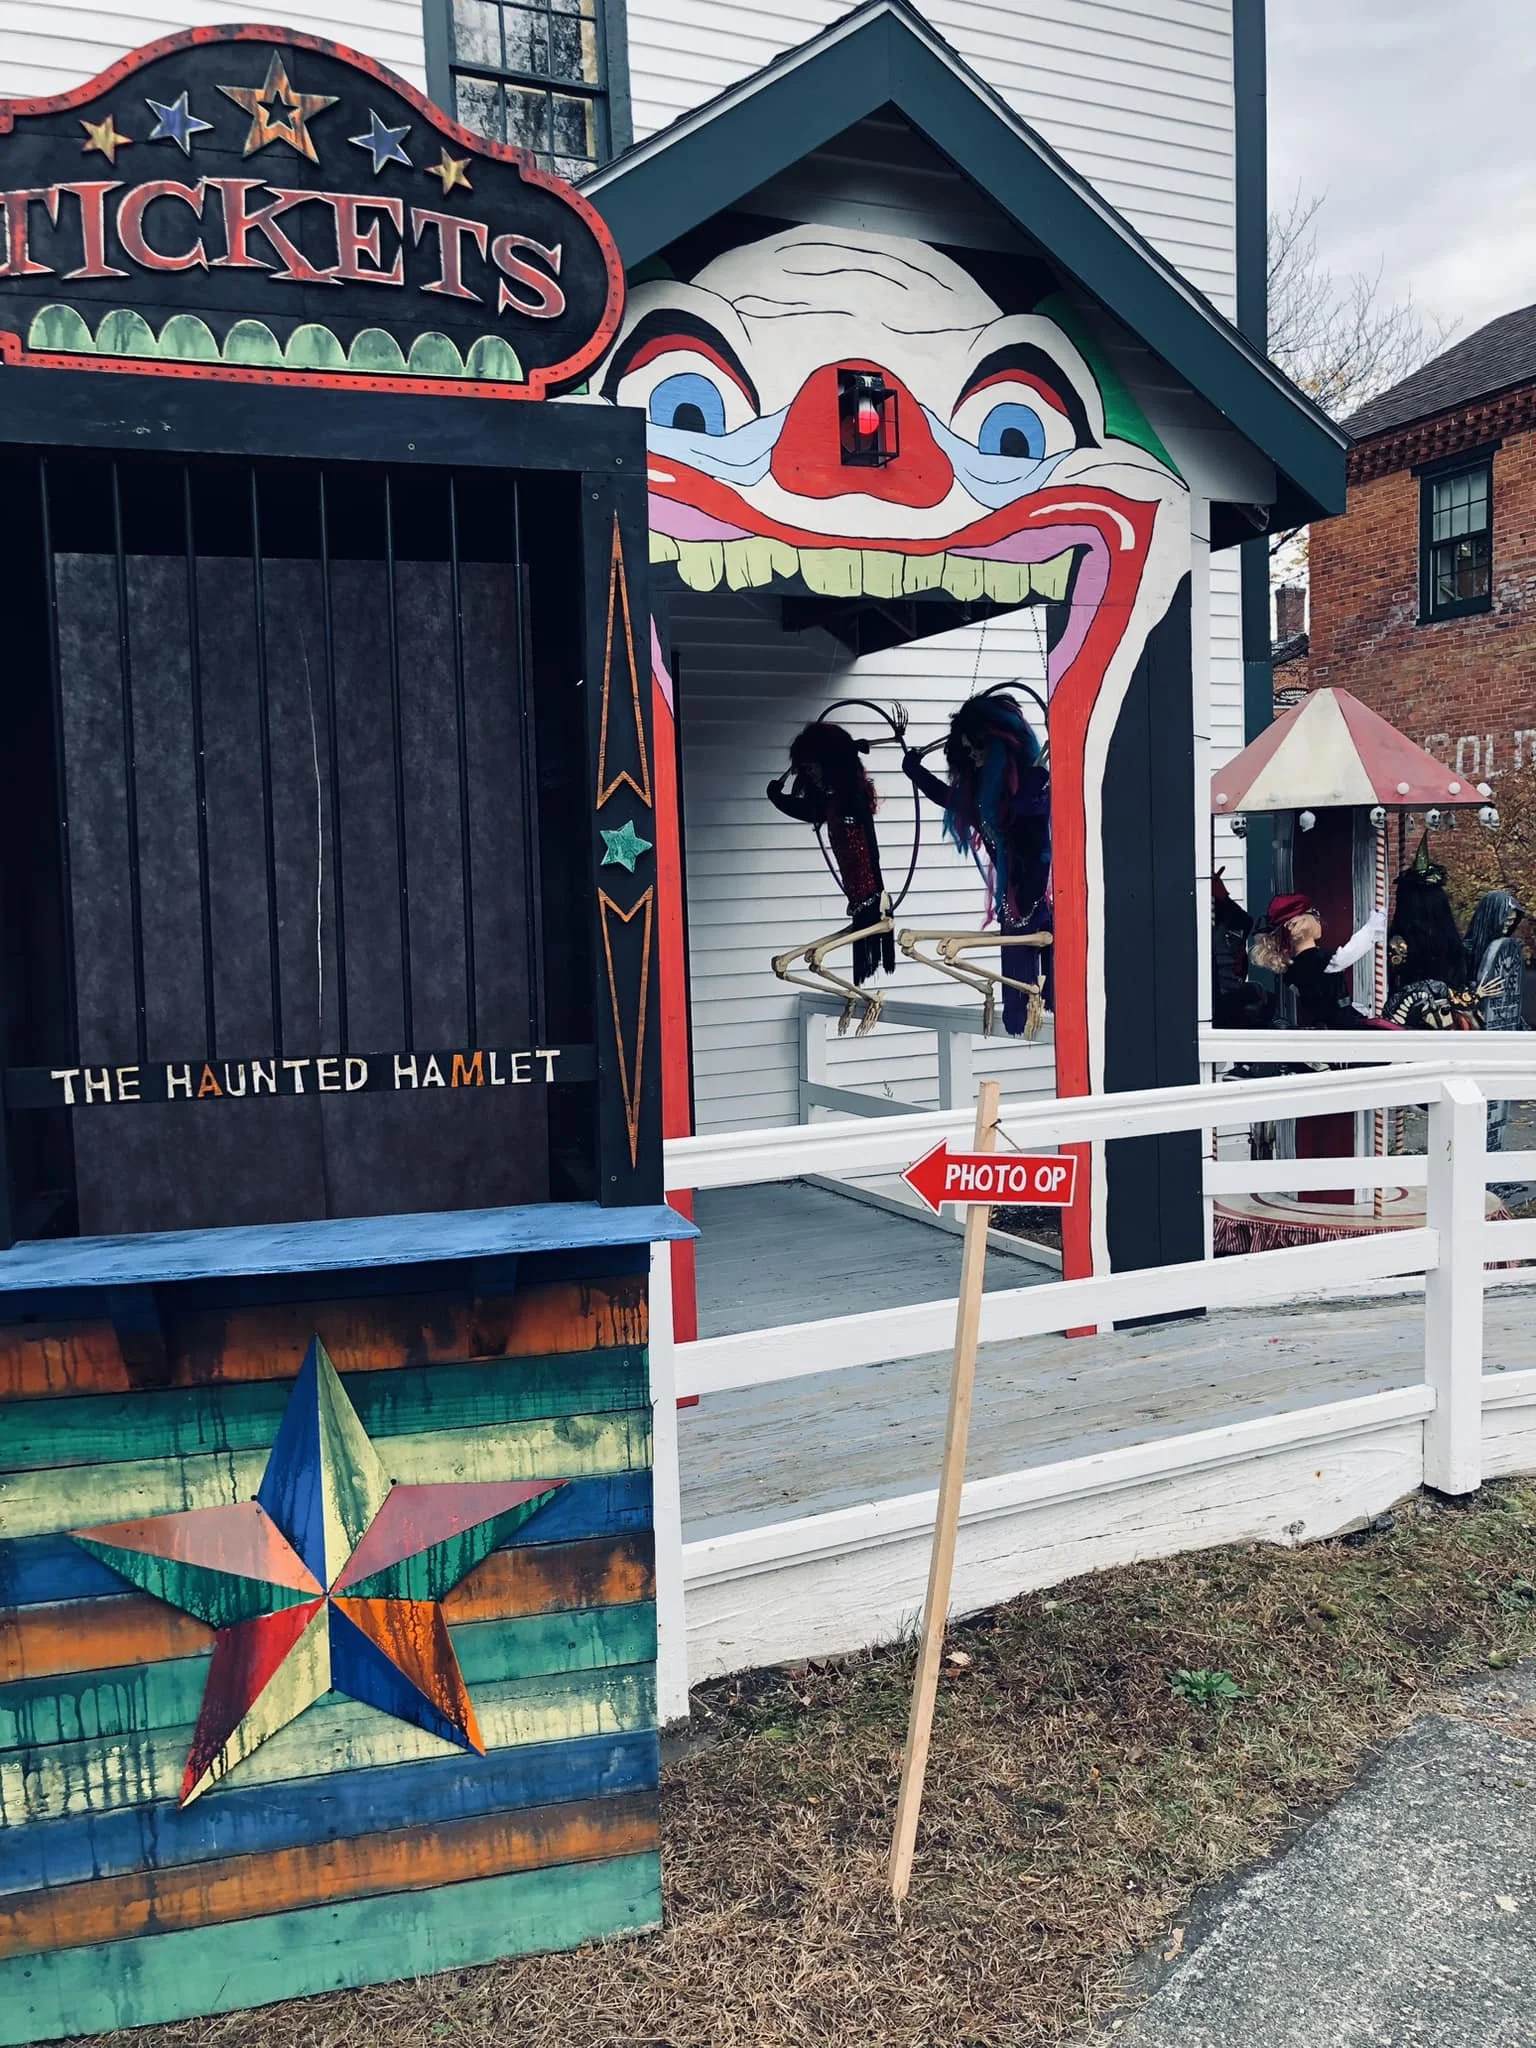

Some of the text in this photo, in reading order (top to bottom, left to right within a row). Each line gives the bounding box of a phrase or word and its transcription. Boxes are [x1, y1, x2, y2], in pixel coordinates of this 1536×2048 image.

[0, 176, 566, 319] TICKETS
[51, 1049, 561, 1104] THE HAUNTED HAMLET
[945, 1163, 1067, 1193] PHOTO OP
